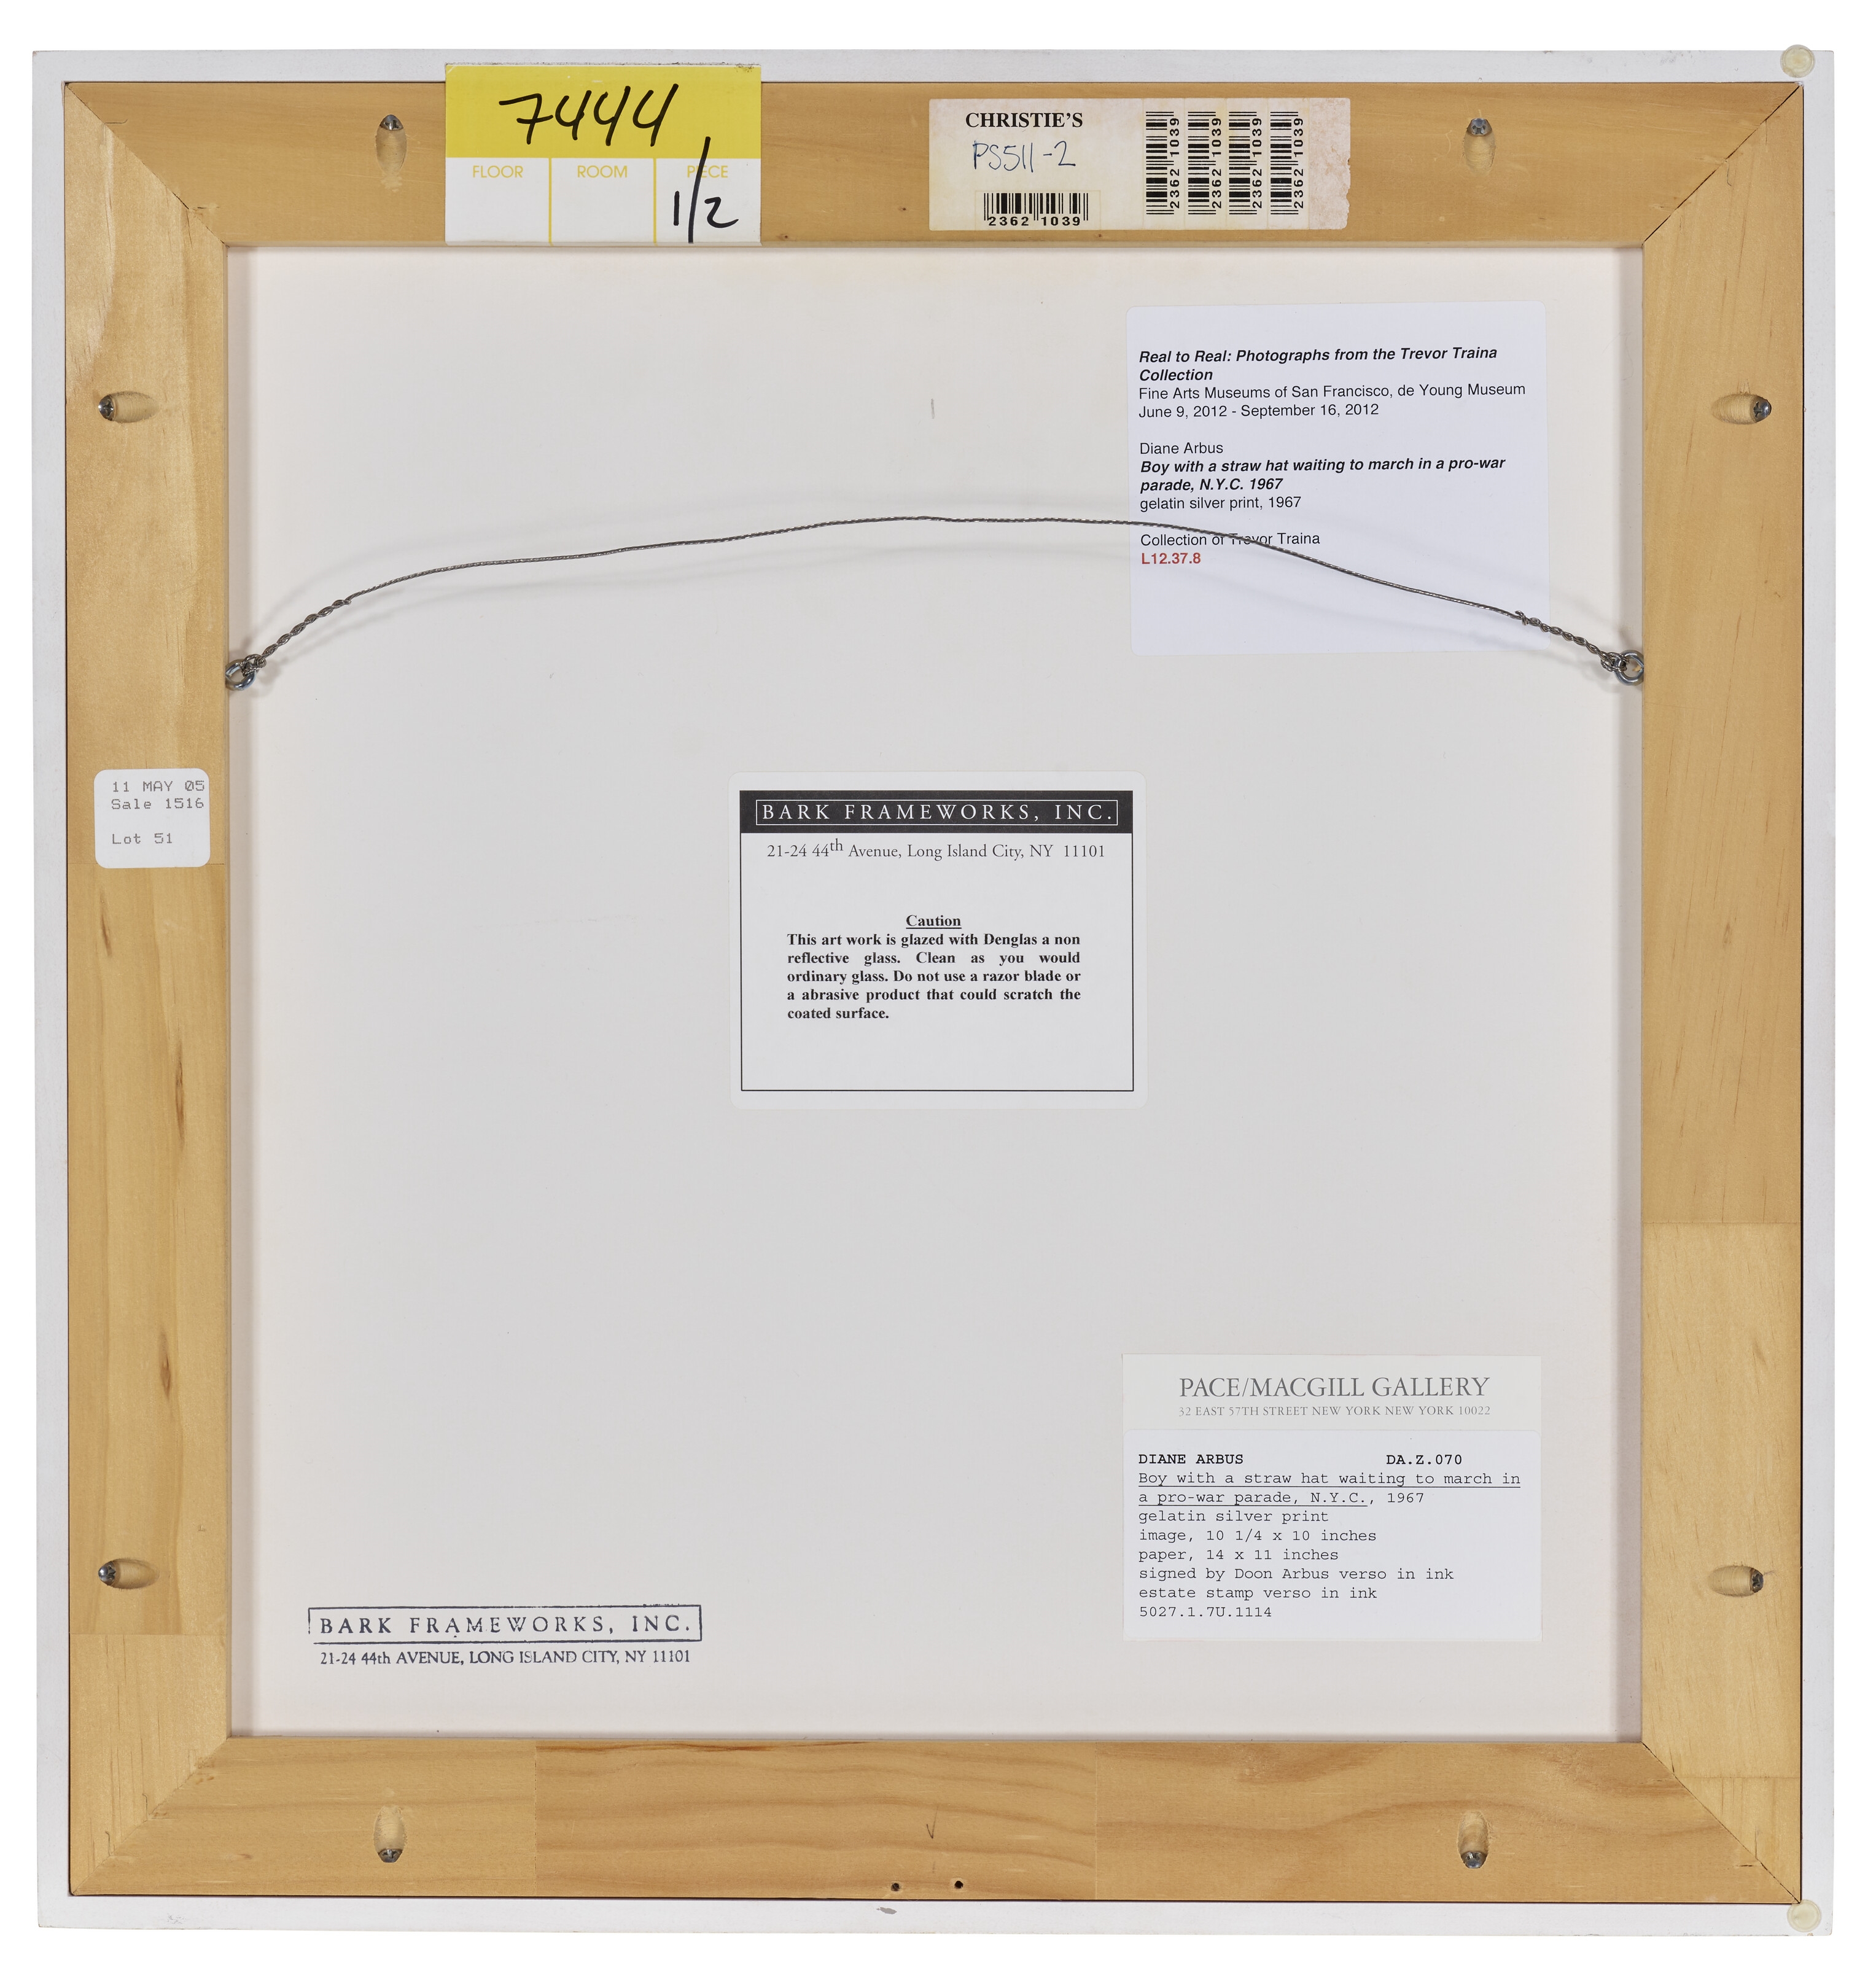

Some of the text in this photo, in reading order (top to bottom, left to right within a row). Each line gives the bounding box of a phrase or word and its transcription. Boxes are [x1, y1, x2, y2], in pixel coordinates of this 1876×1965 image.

[499, 84, 679, 147] 7444
[965, 112, 1083, 128] CHRISTIE'S
[1169, 117, 1180, 209] 2362 1039
[1211, 117, 1222, 209] 2362 1039
[1251, 117, 1263, 209] 2362 1039
[1293, 117, 1304, 209] 2362 1039
[473, 165, 523, 179] FLOOR
[577, 165, 628, 179] ROOM
[687, 165, 729, 179] PECE
[673, 136, 739, 244] 1/2
[988, 216, 1081, 226] 2362 1039
[1139, 346, 1498, 364] Real to Real: Photographs from the Trevor Traina
[1139, 368, 1213, 381] Collection
[1139, 383, 1525, 400] Fine Arts Museums of San Francisco, de Young Museum
[1140, 442, 1223, 454] Diane Arbus
[1140, 457, 1506, 476] Boy with a straw hat waiting to march in a pro-war
[1140, 478, 1284, 494] parade, N.Y.C. 1967
[1140, 496, 1301, 513] gelatin silver print, 1967
[1140, 534, 1207, 546] Collection
[1277, 532, 1321, 545] Traina
[1141, 553, 1202, 564] L12.37.8
[113, 780, 205, 793] 11 MAY 05
[111, 797, 204, 810] Sale 1516
[762, 804, 1111, 822] BARK FRAMEWORKS, INC.
[112, 832, 173, 844] Lot 51
[767, 844, 807, 857] 21-24
[848, 844, 901, 859] Avenue,
[908, 844, 943, 862] Long
[948, 843, 987, 857] Island
[992, 844, 1024, 861] City,
[1029, 844, 1054, 857] NY
[1064, 845, 1104, 857] 11101
[906, 914, 961, 927] Caution
[787, 933, 1080, 949] This art work is glazed with Denglas a non
[787, 951, 1080, 967] reflective glass. Clean as you would
[787, 1006, 889, 1019] coated surface.
[1179, 1377, 1490, 1397] PACE/MACGILL GALLERY
[1178, 1406, 1490, 1416] 32 EAST 57TH STREET NEW YORK NEW YORK 10022
[1138, 1453, 1244, 1465] DIANE ARBUS
[1386, 1454, 1462, 1465] DA.Z.070
[1138, 1471, 1520, 1487] Boy with a straw hat waiting to march in
[1138, 1491, 1424, 1506] a pro-war parade, N.Y.C., 1967
[1138, 1509, 1329, 1525] gelatin silver print
[1140, 1528, 1376, 1544] image, 10 1/4 x 10 inches
[1138, 1548, 1338, 1563] paper, 14 x 11 inches
[1140, 1606, 1272, 1617] 5027.1.7U.1114
[320, 1614, 690, 1635] BARK FRAMEWORKS, INC.
[320, 1649, 690, 1666] 21-24 44th AVENUE, LONG ISLAND CITY, NY 11101
